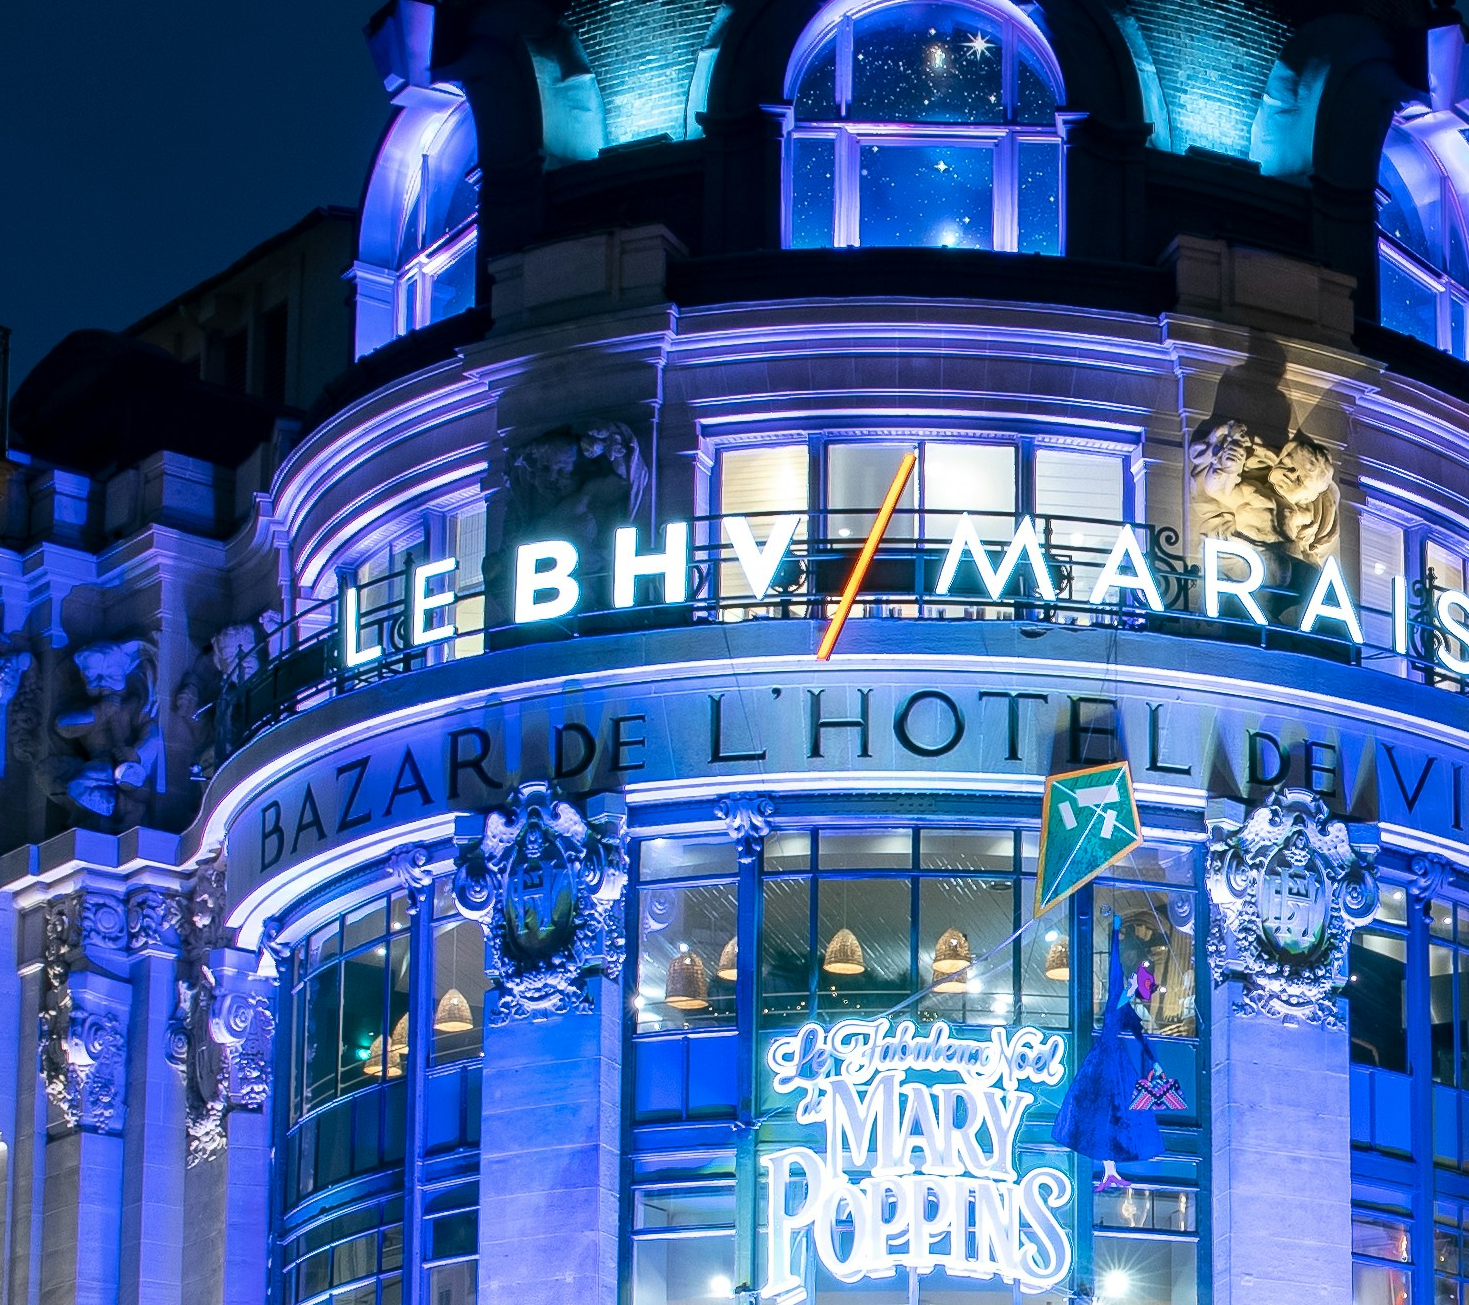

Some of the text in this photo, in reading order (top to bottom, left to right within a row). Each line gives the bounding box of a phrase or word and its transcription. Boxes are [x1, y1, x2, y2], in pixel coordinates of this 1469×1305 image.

[343, 556, 458, 667] LE
[512, 514, 803, 625] BHV
[258, 727, 504, 876] BAZAR
[552, 713, 647, 781] DE
[1245, 729, 1338, 796] DE
[771, 1024, 831, 1089] Le
[832, 1020, 991, 1081] Fabuleux
[799, 1087, 828, 1122] de
[827, 1072, 1034, 1180] MARY
[760, 1147, 1071, 1300] POPPINS
